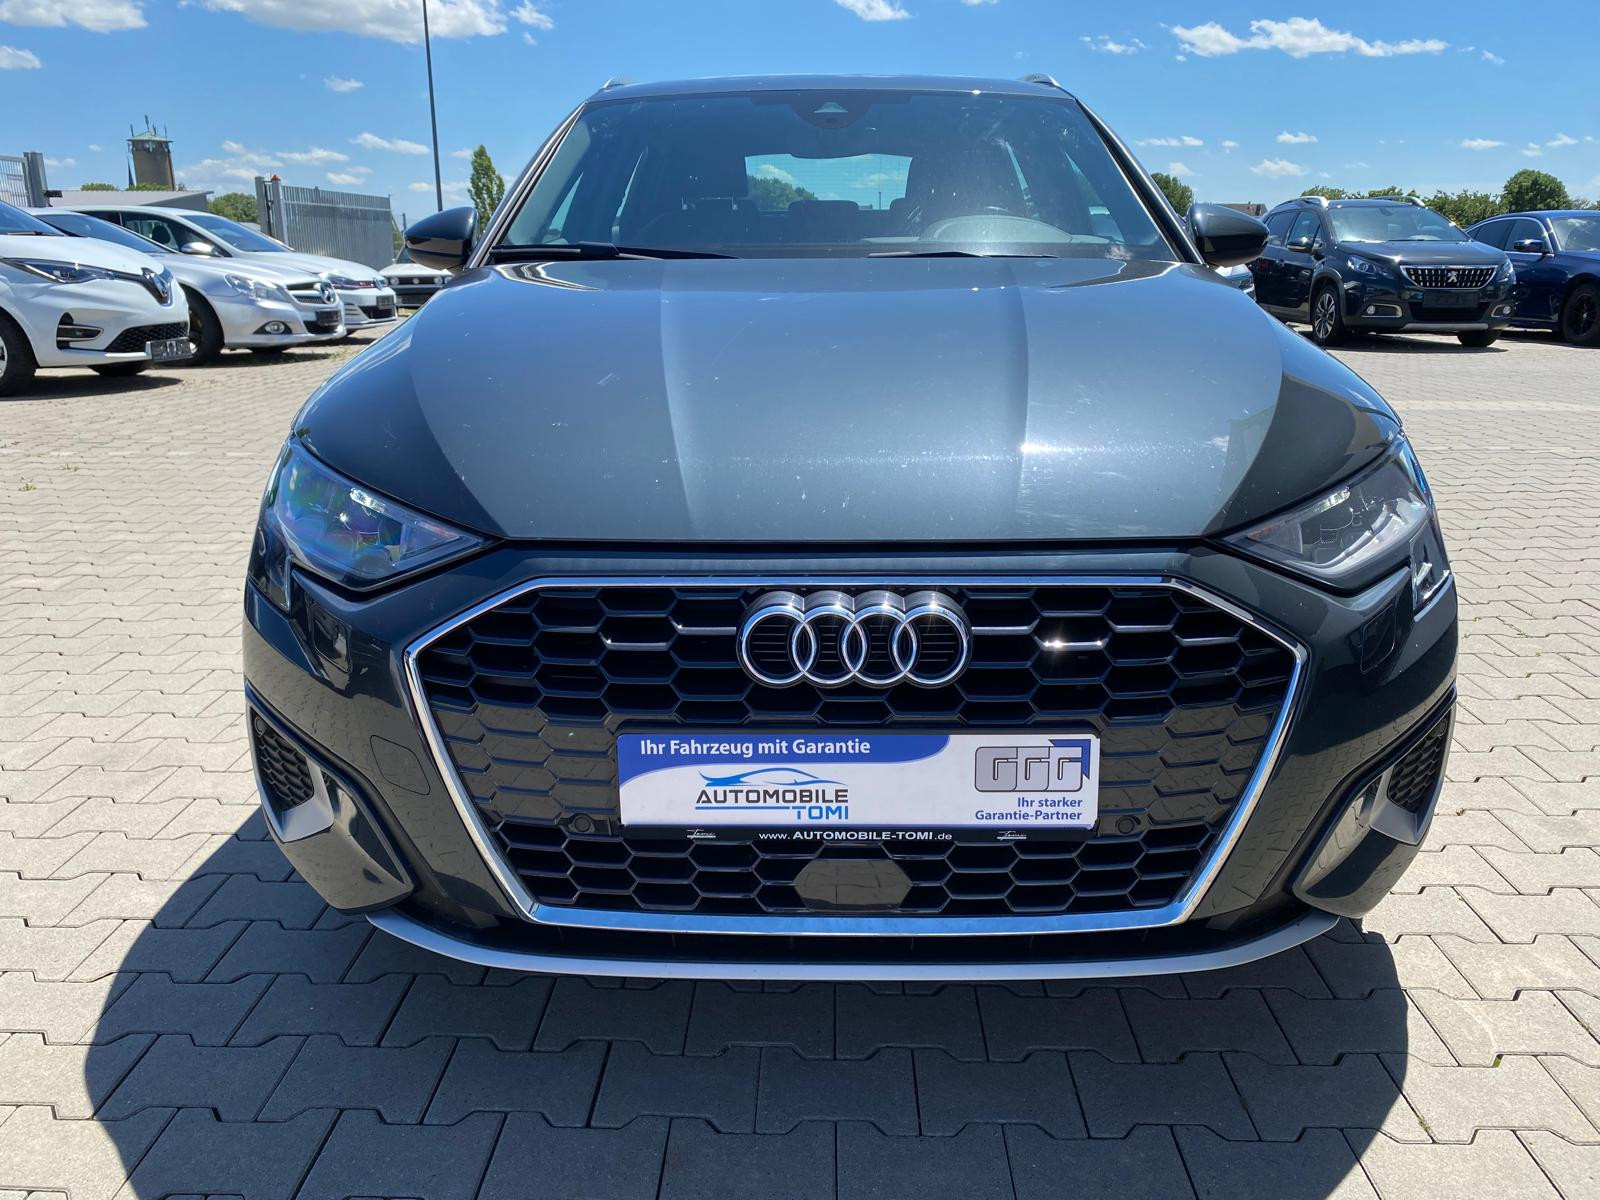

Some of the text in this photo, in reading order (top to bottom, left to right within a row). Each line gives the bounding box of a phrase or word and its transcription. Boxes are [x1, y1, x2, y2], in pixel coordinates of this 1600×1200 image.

[640, 738, 871, 758] Ihr Fahrzeug mit Garantie
[695, 788, 849, 804] AUTOMOBILE
[1017, 796, 1083, 807] Ihr starker
[791, 805, 849, 820] TOMI
[975, 810, 1082, 820] Garantie-Partner
